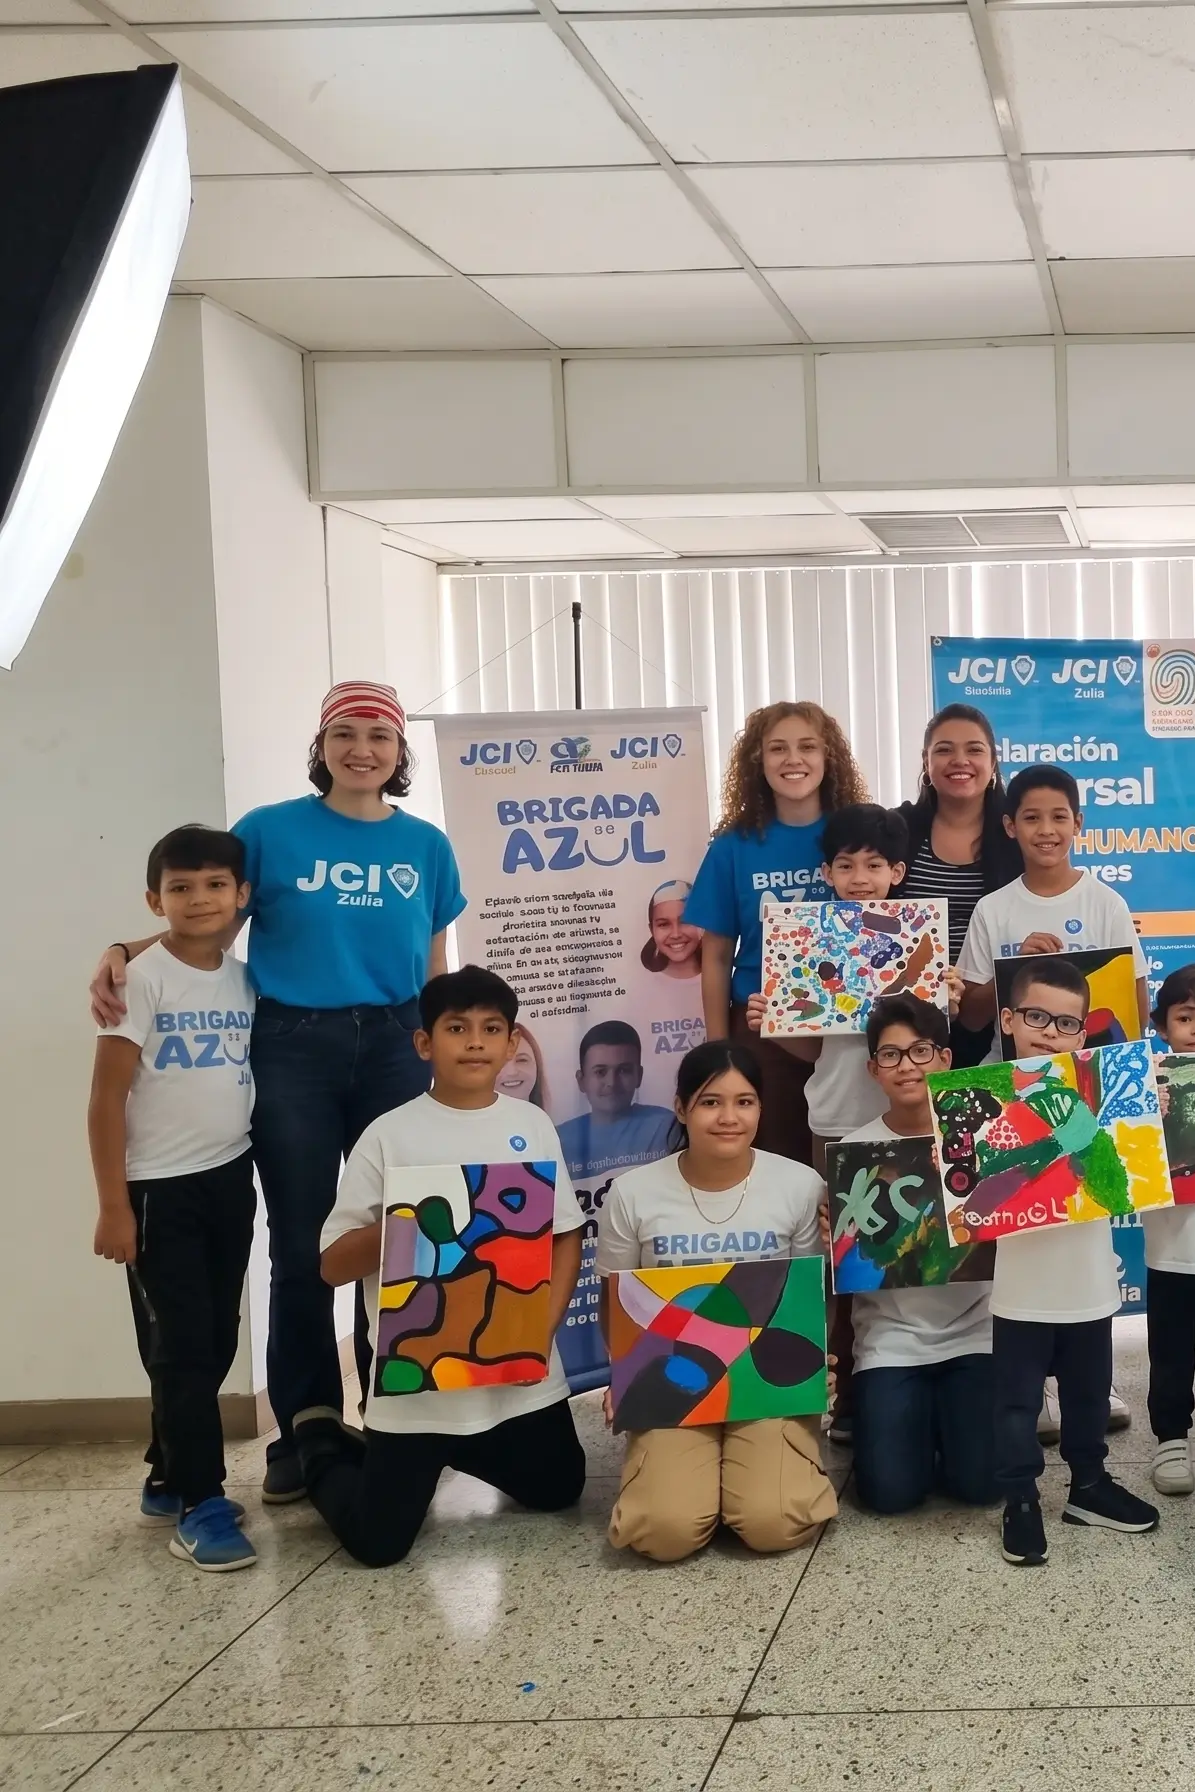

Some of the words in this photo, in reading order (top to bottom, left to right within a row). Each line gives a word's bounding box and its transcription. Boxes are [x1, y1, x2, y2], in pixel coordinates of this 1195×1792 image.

[948, 658, 1007, 684] JCI
[1052, 659, 1108, 684] JCI
[1074, 688, 1105, 699] Zulia
[460, 742, 512, 766] JCI
[610, 737, 659, 760] JCI
[995, 735, 1118, 763] claración
[1074, 766, 1155, 806] rsal
[496, 791, 661, 826] BRIGADA
[296, 860, 382, 894] JCI
[752, 867, 825, 890] BRIGA
[336, 893, 384, 908] Zulia
[651, 1017, 706, 1034] BRIGA
[154, 1033, 251, 1071] AZU
[655, 1033, 707, 1055] AZ
[653, 1231, 779, 1255] BRIGADA
